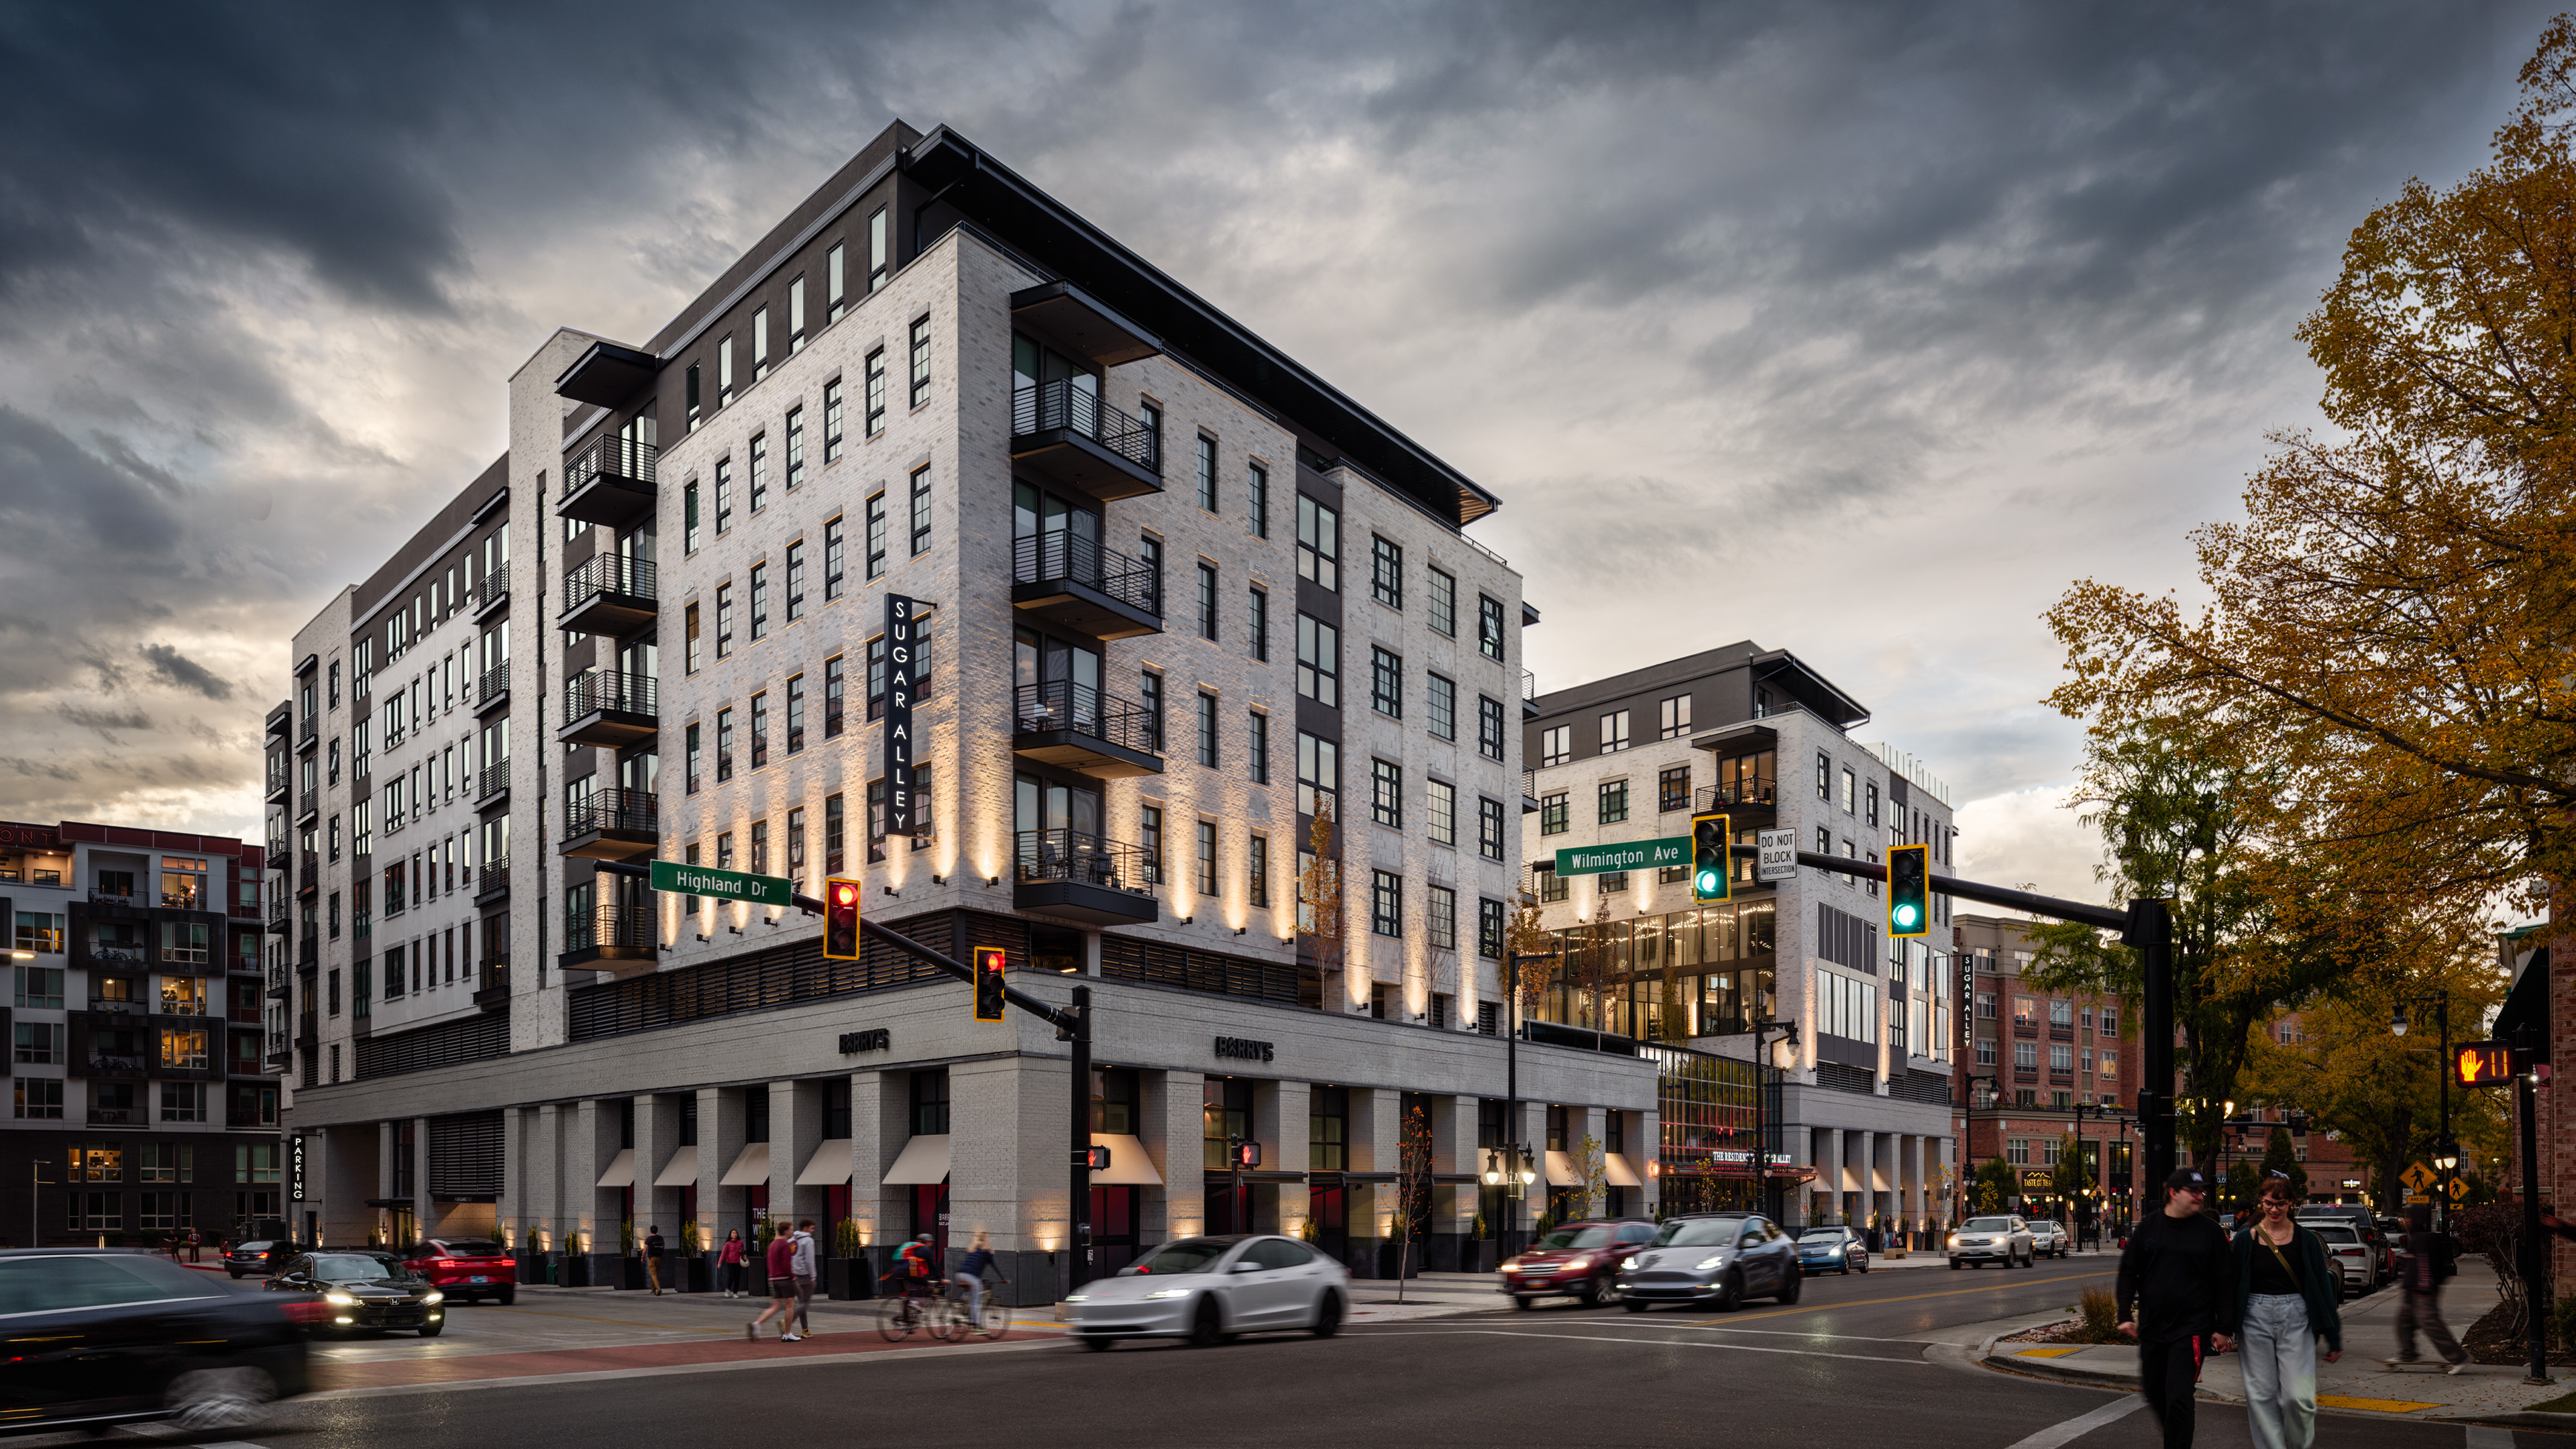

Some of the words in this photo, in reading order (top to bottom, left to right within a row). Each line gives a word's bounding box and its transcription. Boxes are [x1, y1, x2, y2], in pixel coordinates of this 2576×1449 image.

[893, 601, 908, 708] SUGAR
[894, 724, 907, 829] ALLEY
[1762, 836, 1773, 848] DO
[1777, 833, 1793, 847] NOT
[1572, 849, 1644, 869] Wilmington
[1654, 846, 1678, 861] Ave
[1764, 850, 1792, 864] BLOCK
[1761, 865, 1795, 875] INTERSECTION
[677, 871, 741, 894] Highland
[751, 881, 767, 896] Dr
[839, 1028, 890, 1054] BARRY'S
[1216, 1036, 1274, 1061] BARRY'S
[2491, 1051, 2508, 1077] 11
[293, 1138, 303, 1199] PARKING
[1713, 1151, 1725, 1161] THE
[1777, 1154, 1791, 1164] ALLEY
[2024, 1179, 2037, 1187] TASTE
[753, 1208, 766, 1219] THE
